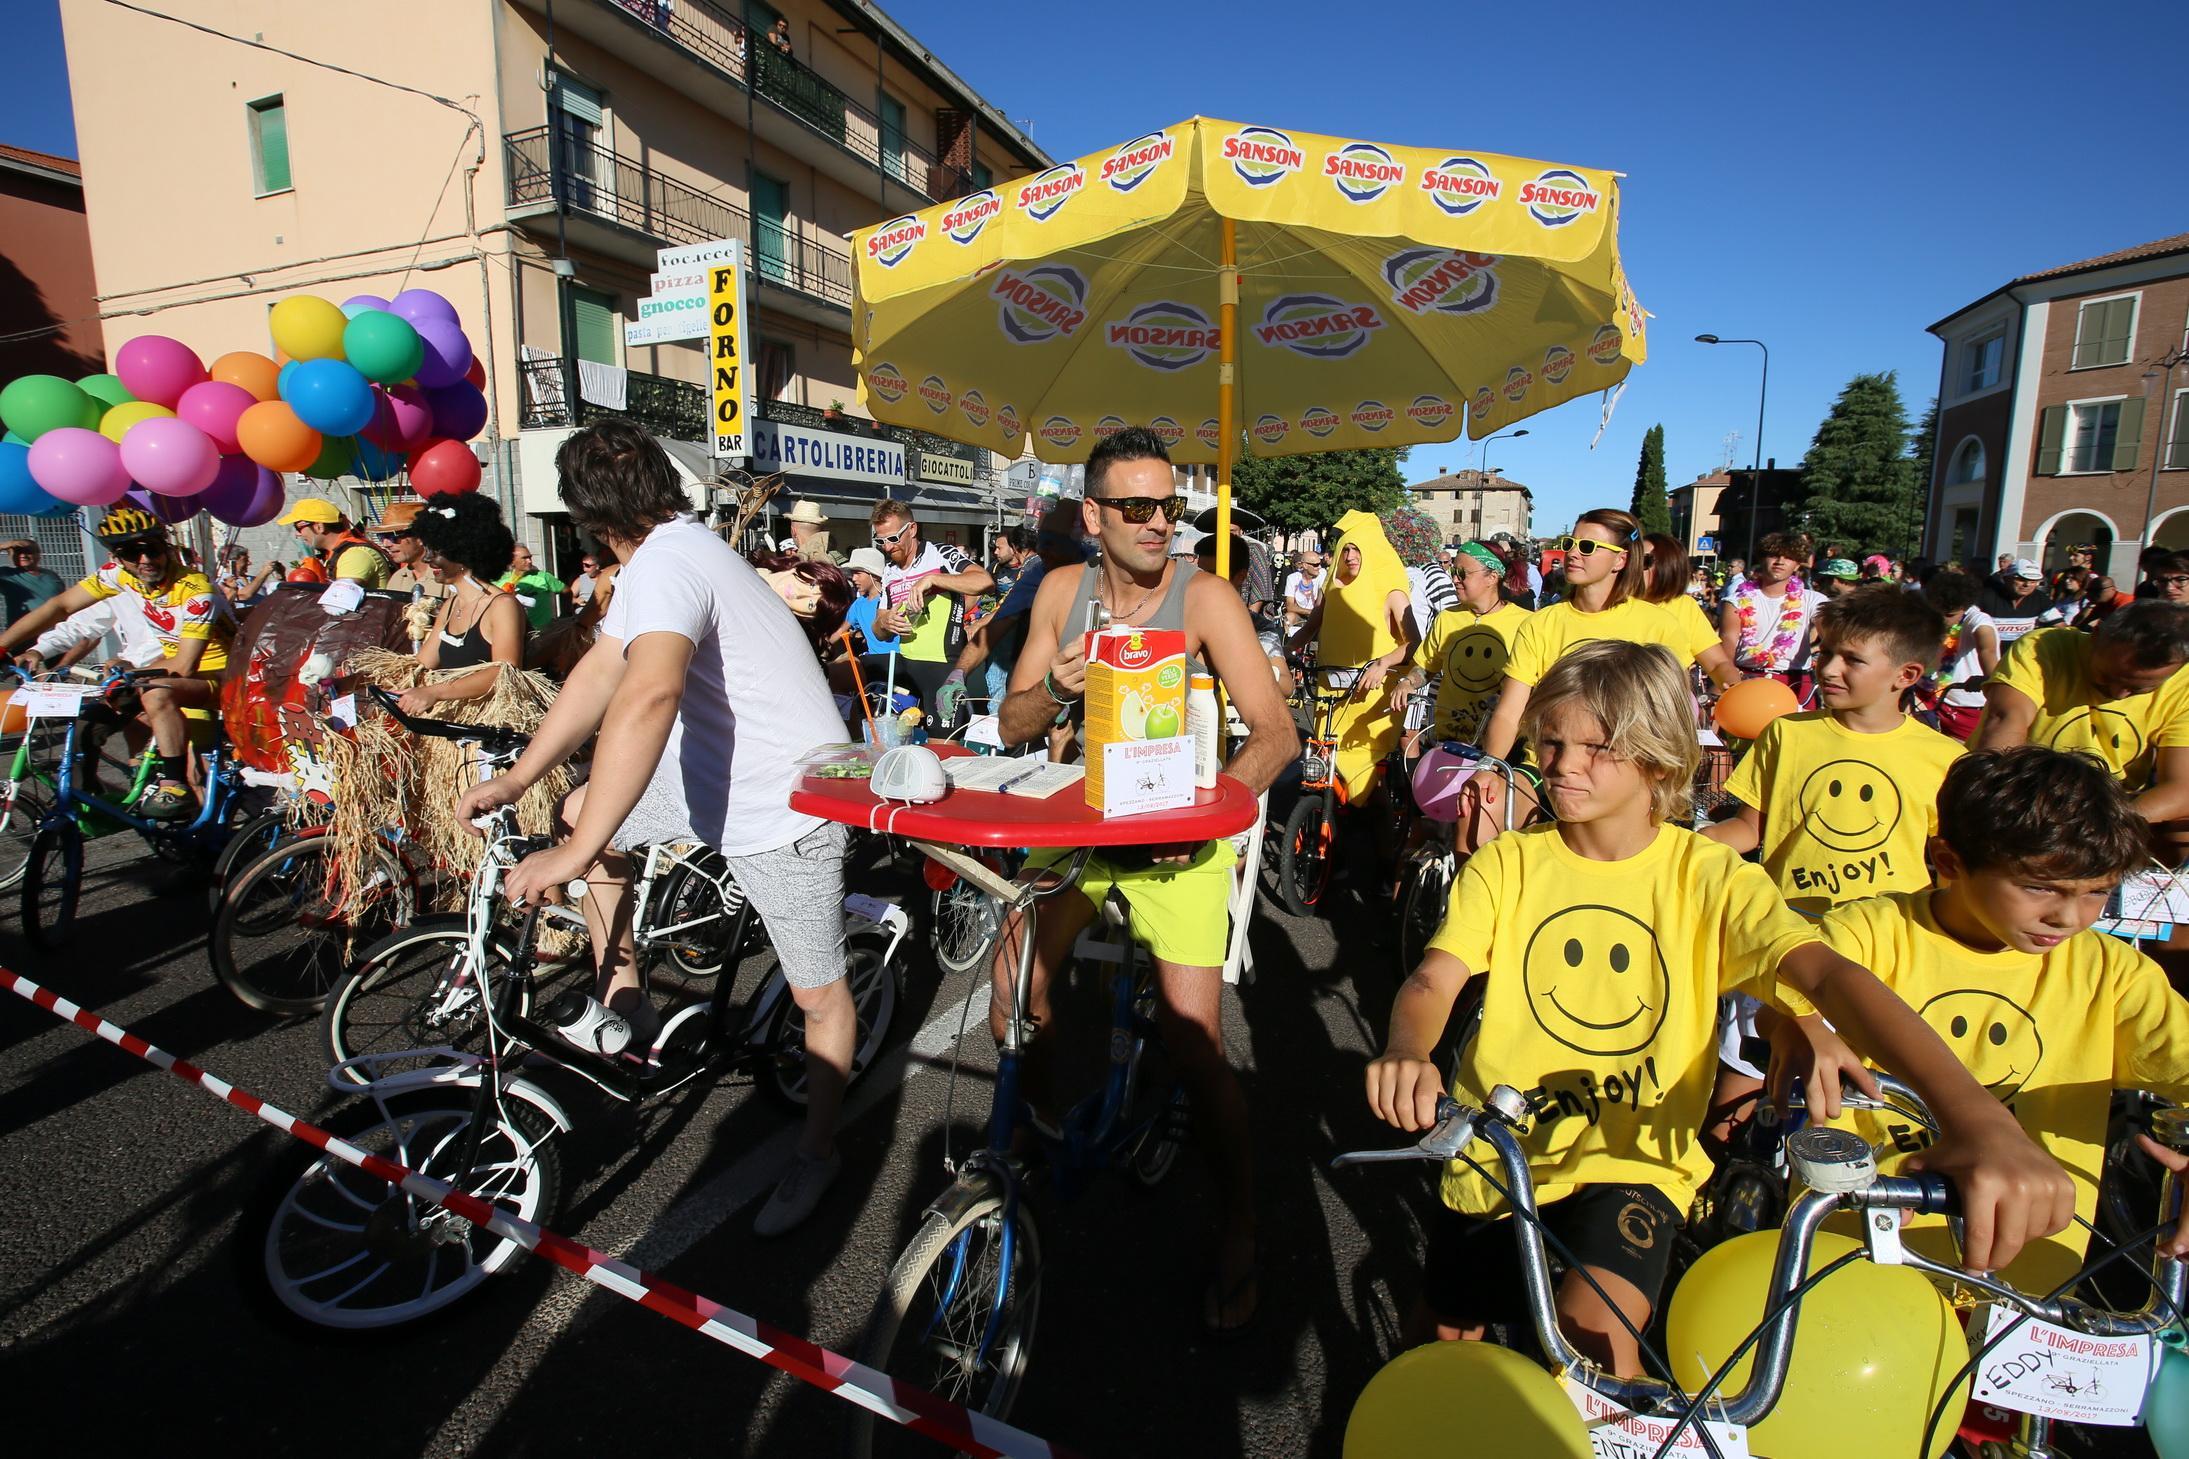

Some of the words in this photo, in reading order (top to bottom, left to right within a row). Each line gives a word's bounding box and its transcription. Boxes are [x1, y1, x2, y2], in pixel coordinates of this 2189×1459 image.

[1101, 139, 1171, 179] SANSON
[1224, 137, 1302, 168] SANSON
[1325, 156, 1403, 182] SANSON
[1018, 171, 1083, 207] SANSON
[1421, 170, 1499, 198] SANSON
[1520, 183, 1598, 209] SANSON
[942, 198, 1000, 232] SANSON
[868, 223, 925, 257] SANSON
[654, 274, 704, 293] pizza
[641, 297, 706, 319] gnocco
[713, 268, 738, 423] FORNO
[718, 434, 742, 452] BAR
[754, 431, 904, 477] CARTOLIBRERIA
[921, 458, 973, 480] GIOCATTOLI
[1124, 649, 1148, 660] bravo
[1124, 742, 1182, 759] L'IMPRESA
[1791, 851, 1896, 895] Enjoy!
[1526, 1056, 1664, 1127] Enjoy!
[2029, 1326, 2138, 1358] L'IMPRESA
[1985, 1349, 2054, 1390] EDDY
[2062, 1355, 2119, 1366] GRAZIELLATA
[2004, 1389, 2055, 1405] SPEZZANO
[2063, 1402, 2129, 1413] SERRAMAZZONI
[1619, 1435, 1688, 1459] GRAZIEATA
